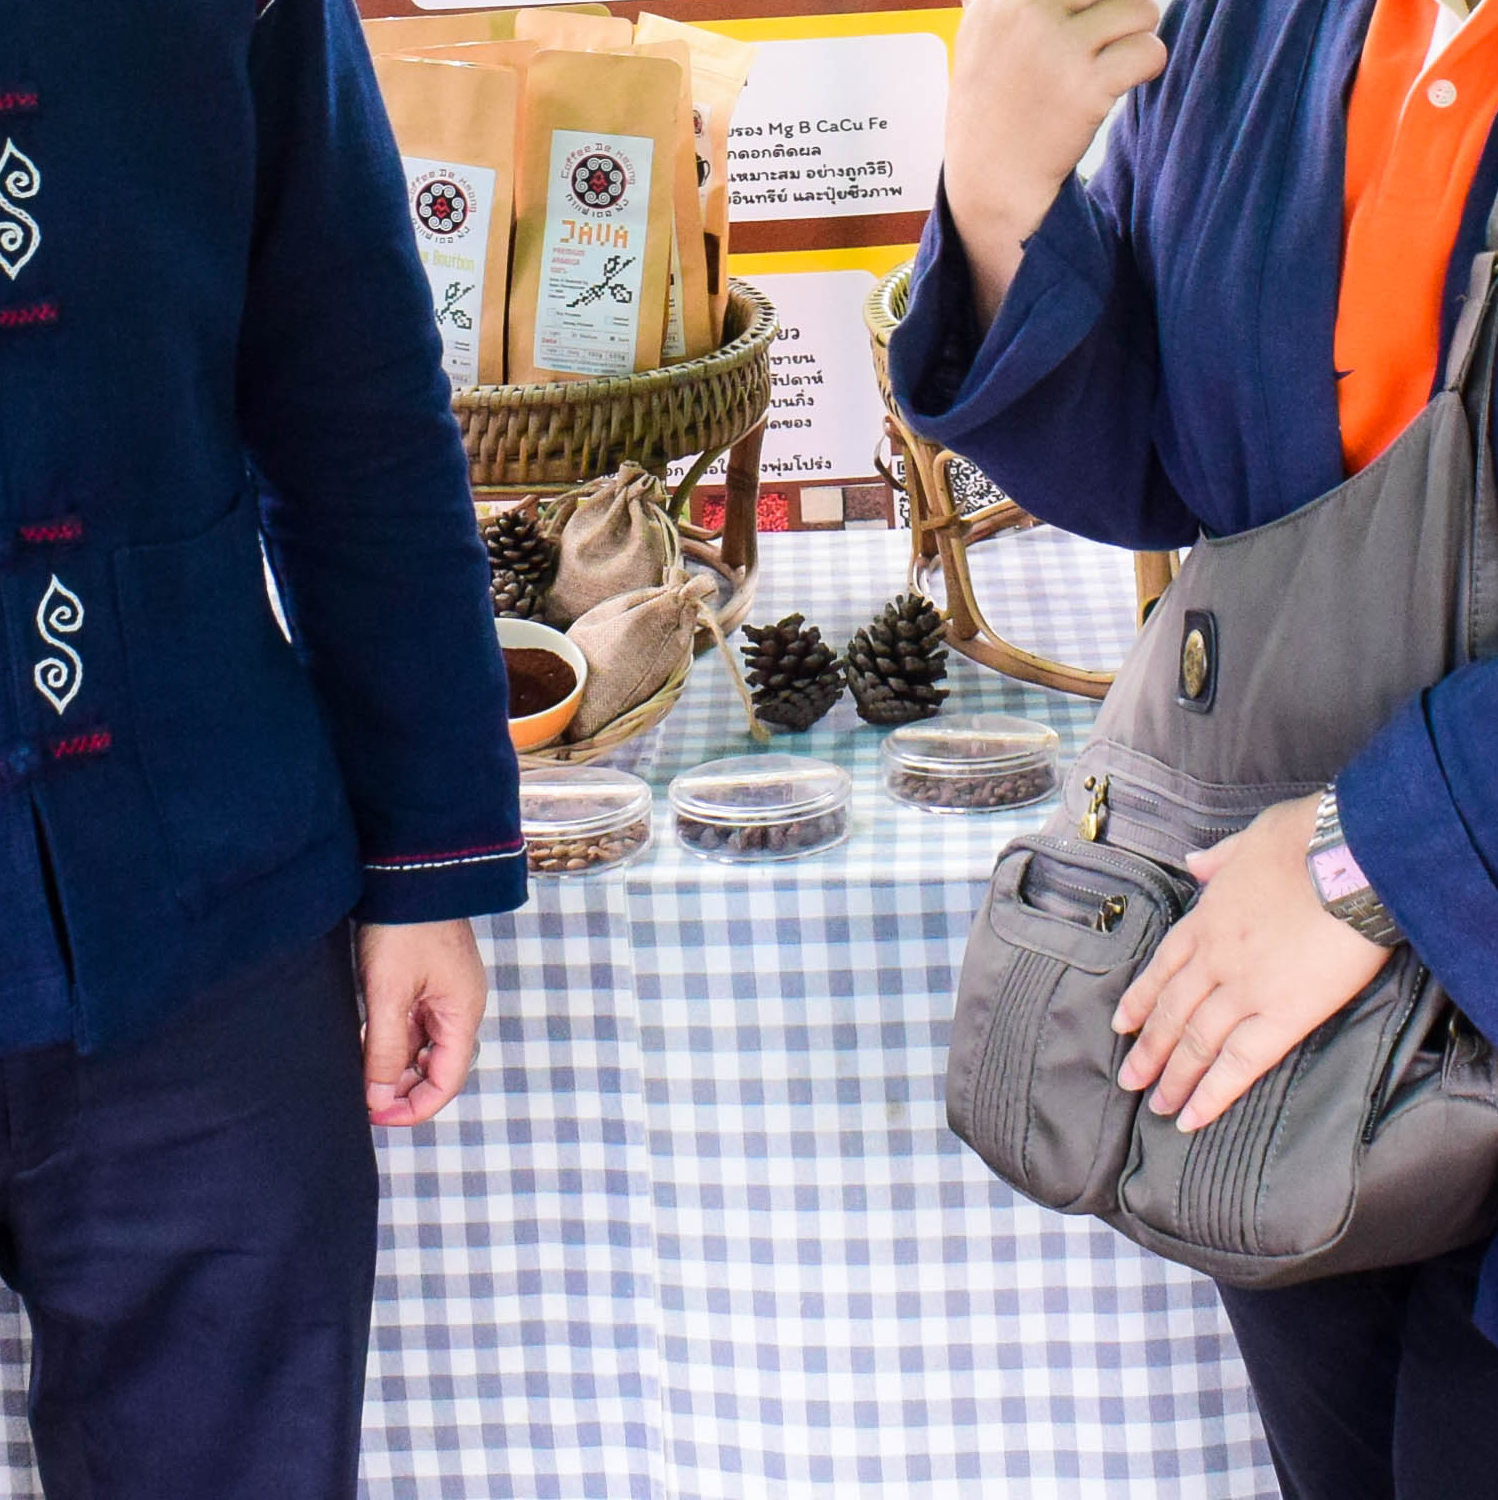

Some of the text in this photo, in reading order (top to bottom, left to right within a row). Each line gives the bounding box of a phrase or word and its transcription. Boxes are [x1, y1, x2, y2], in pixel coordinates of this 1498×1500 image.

[768, 117, 889, 139] Mg B CaCu Fe
[559, 219, 631, 249] JAVA
